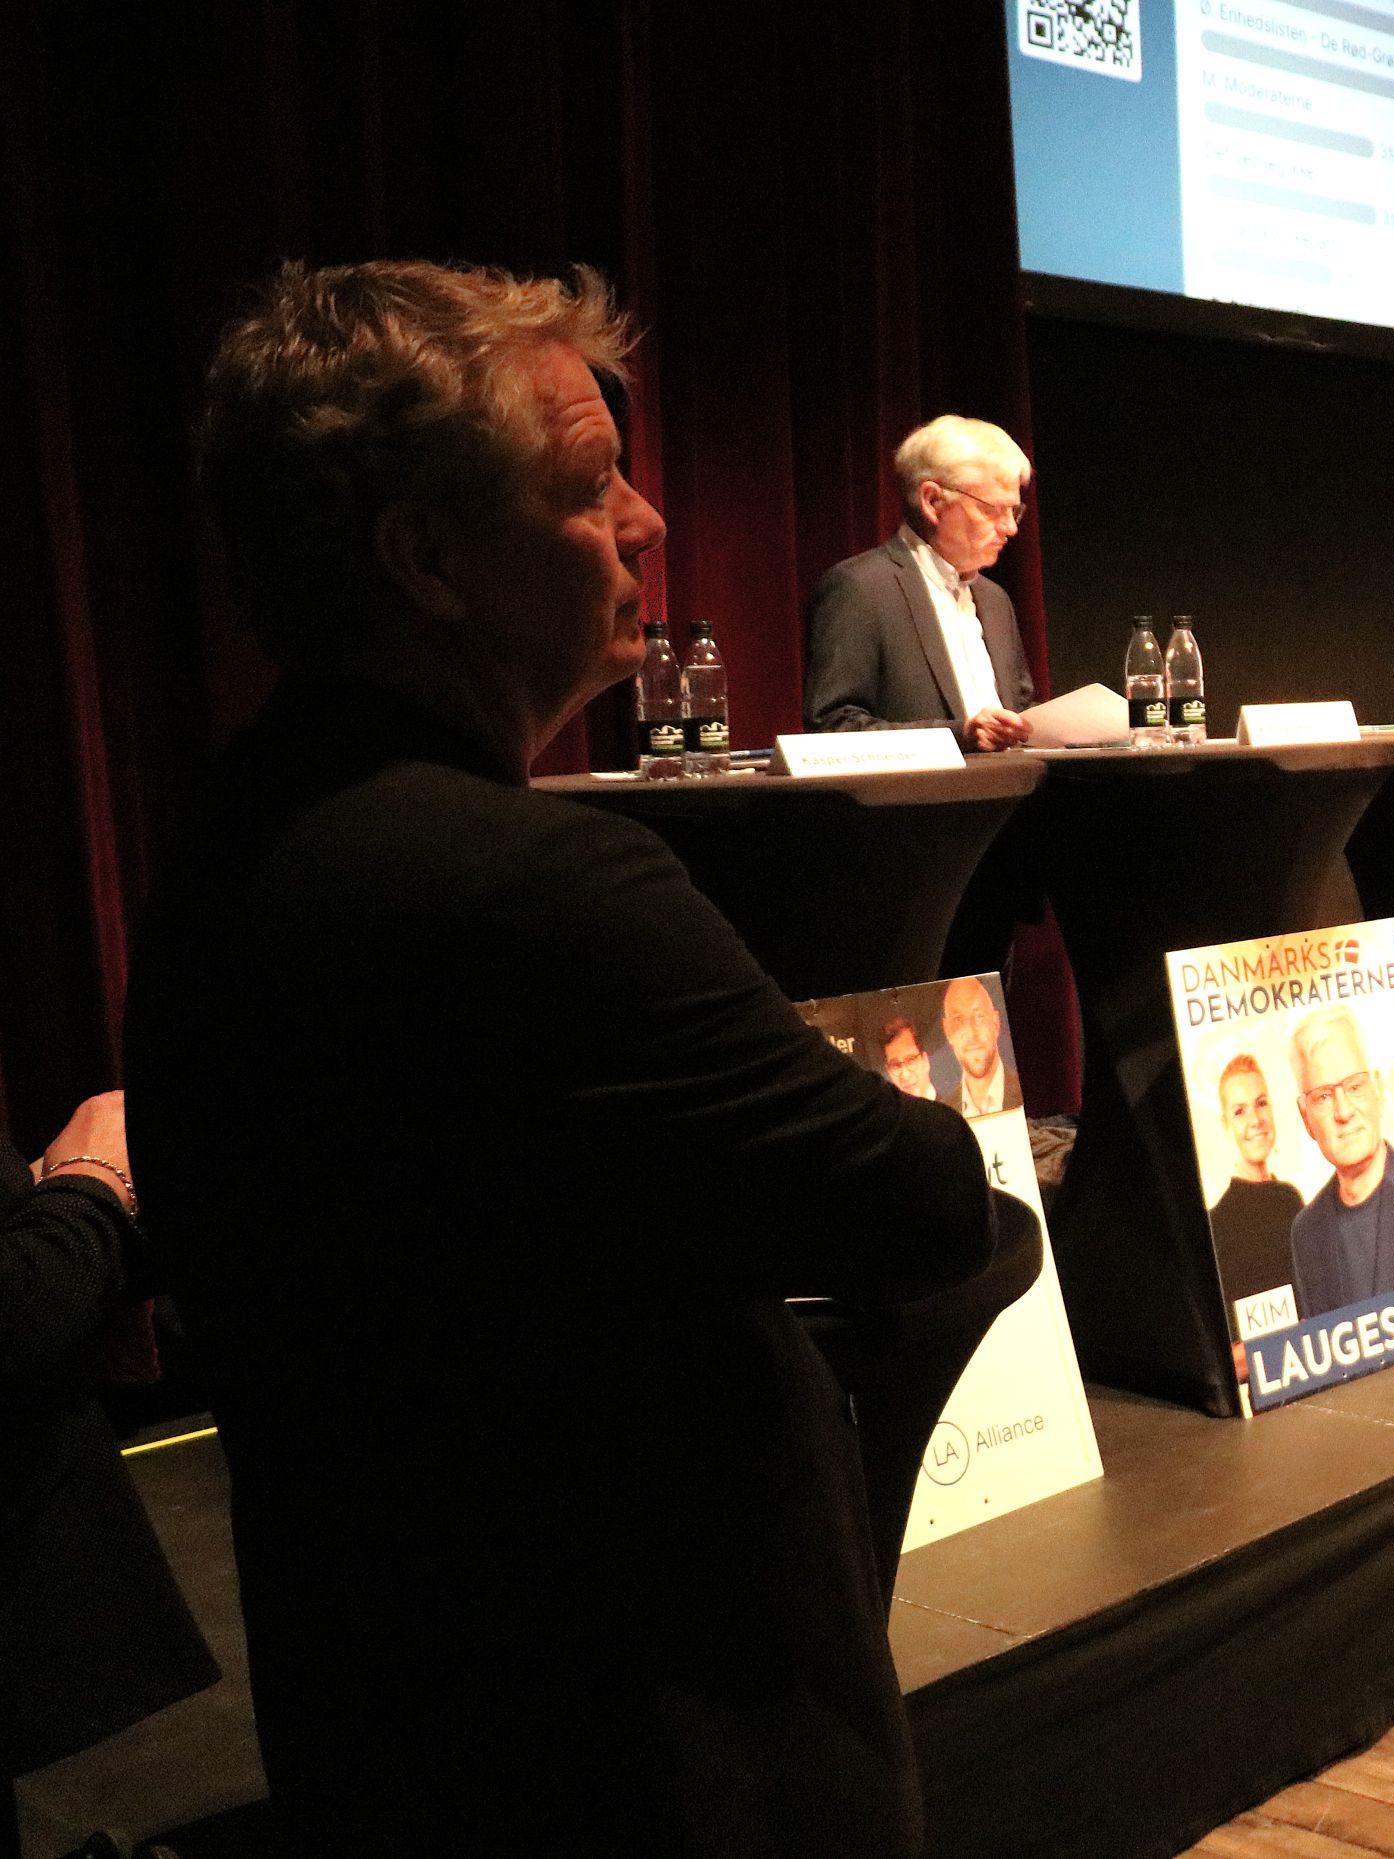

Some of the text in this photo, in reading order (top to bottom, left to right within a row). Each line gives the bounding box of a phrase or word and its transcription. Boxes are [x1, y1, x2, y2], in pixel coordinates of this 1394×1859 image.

[1219, 5, 1308, 43] Enhedslisten
[1322, 32, 1339, 52] De
[1224, 75, 1313, 112] Moderaterne
[1182, 942, 1331, 993] DANMARKS
[1245, 1295, 1292, 1332] KIM
[933, 1415, 1044, 1467] LA Alliance
